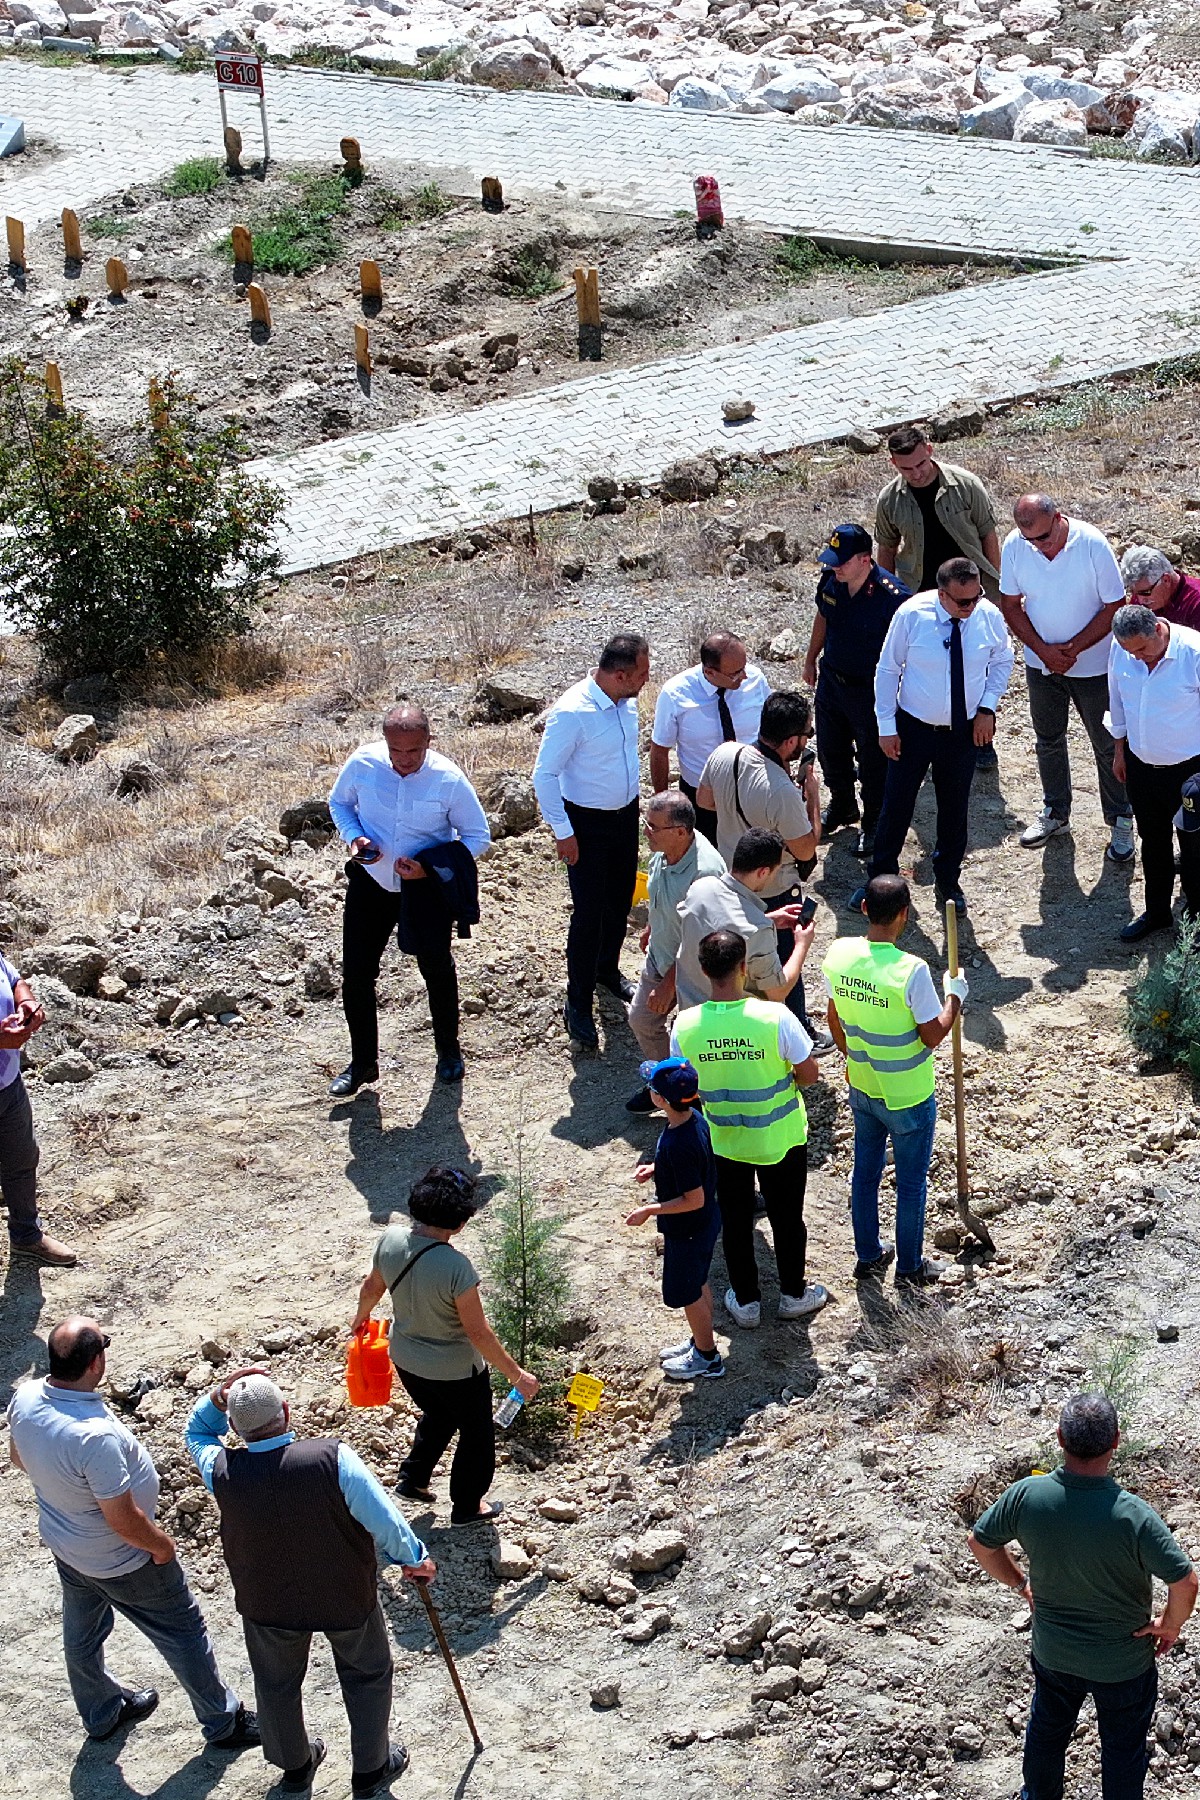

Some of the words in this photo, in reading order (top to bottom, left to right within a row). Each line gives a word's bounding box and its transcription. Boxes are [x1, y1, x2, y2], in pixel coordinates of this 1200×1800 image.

[220, 62, 234, 82] C
[236, 64, 258, 85] 10
[840, 974, 879, 994] TURHAL
[706, 1038, 755, 1050] TURHAL
[698, 1048, 765, 1063] BELEDİYESİ
